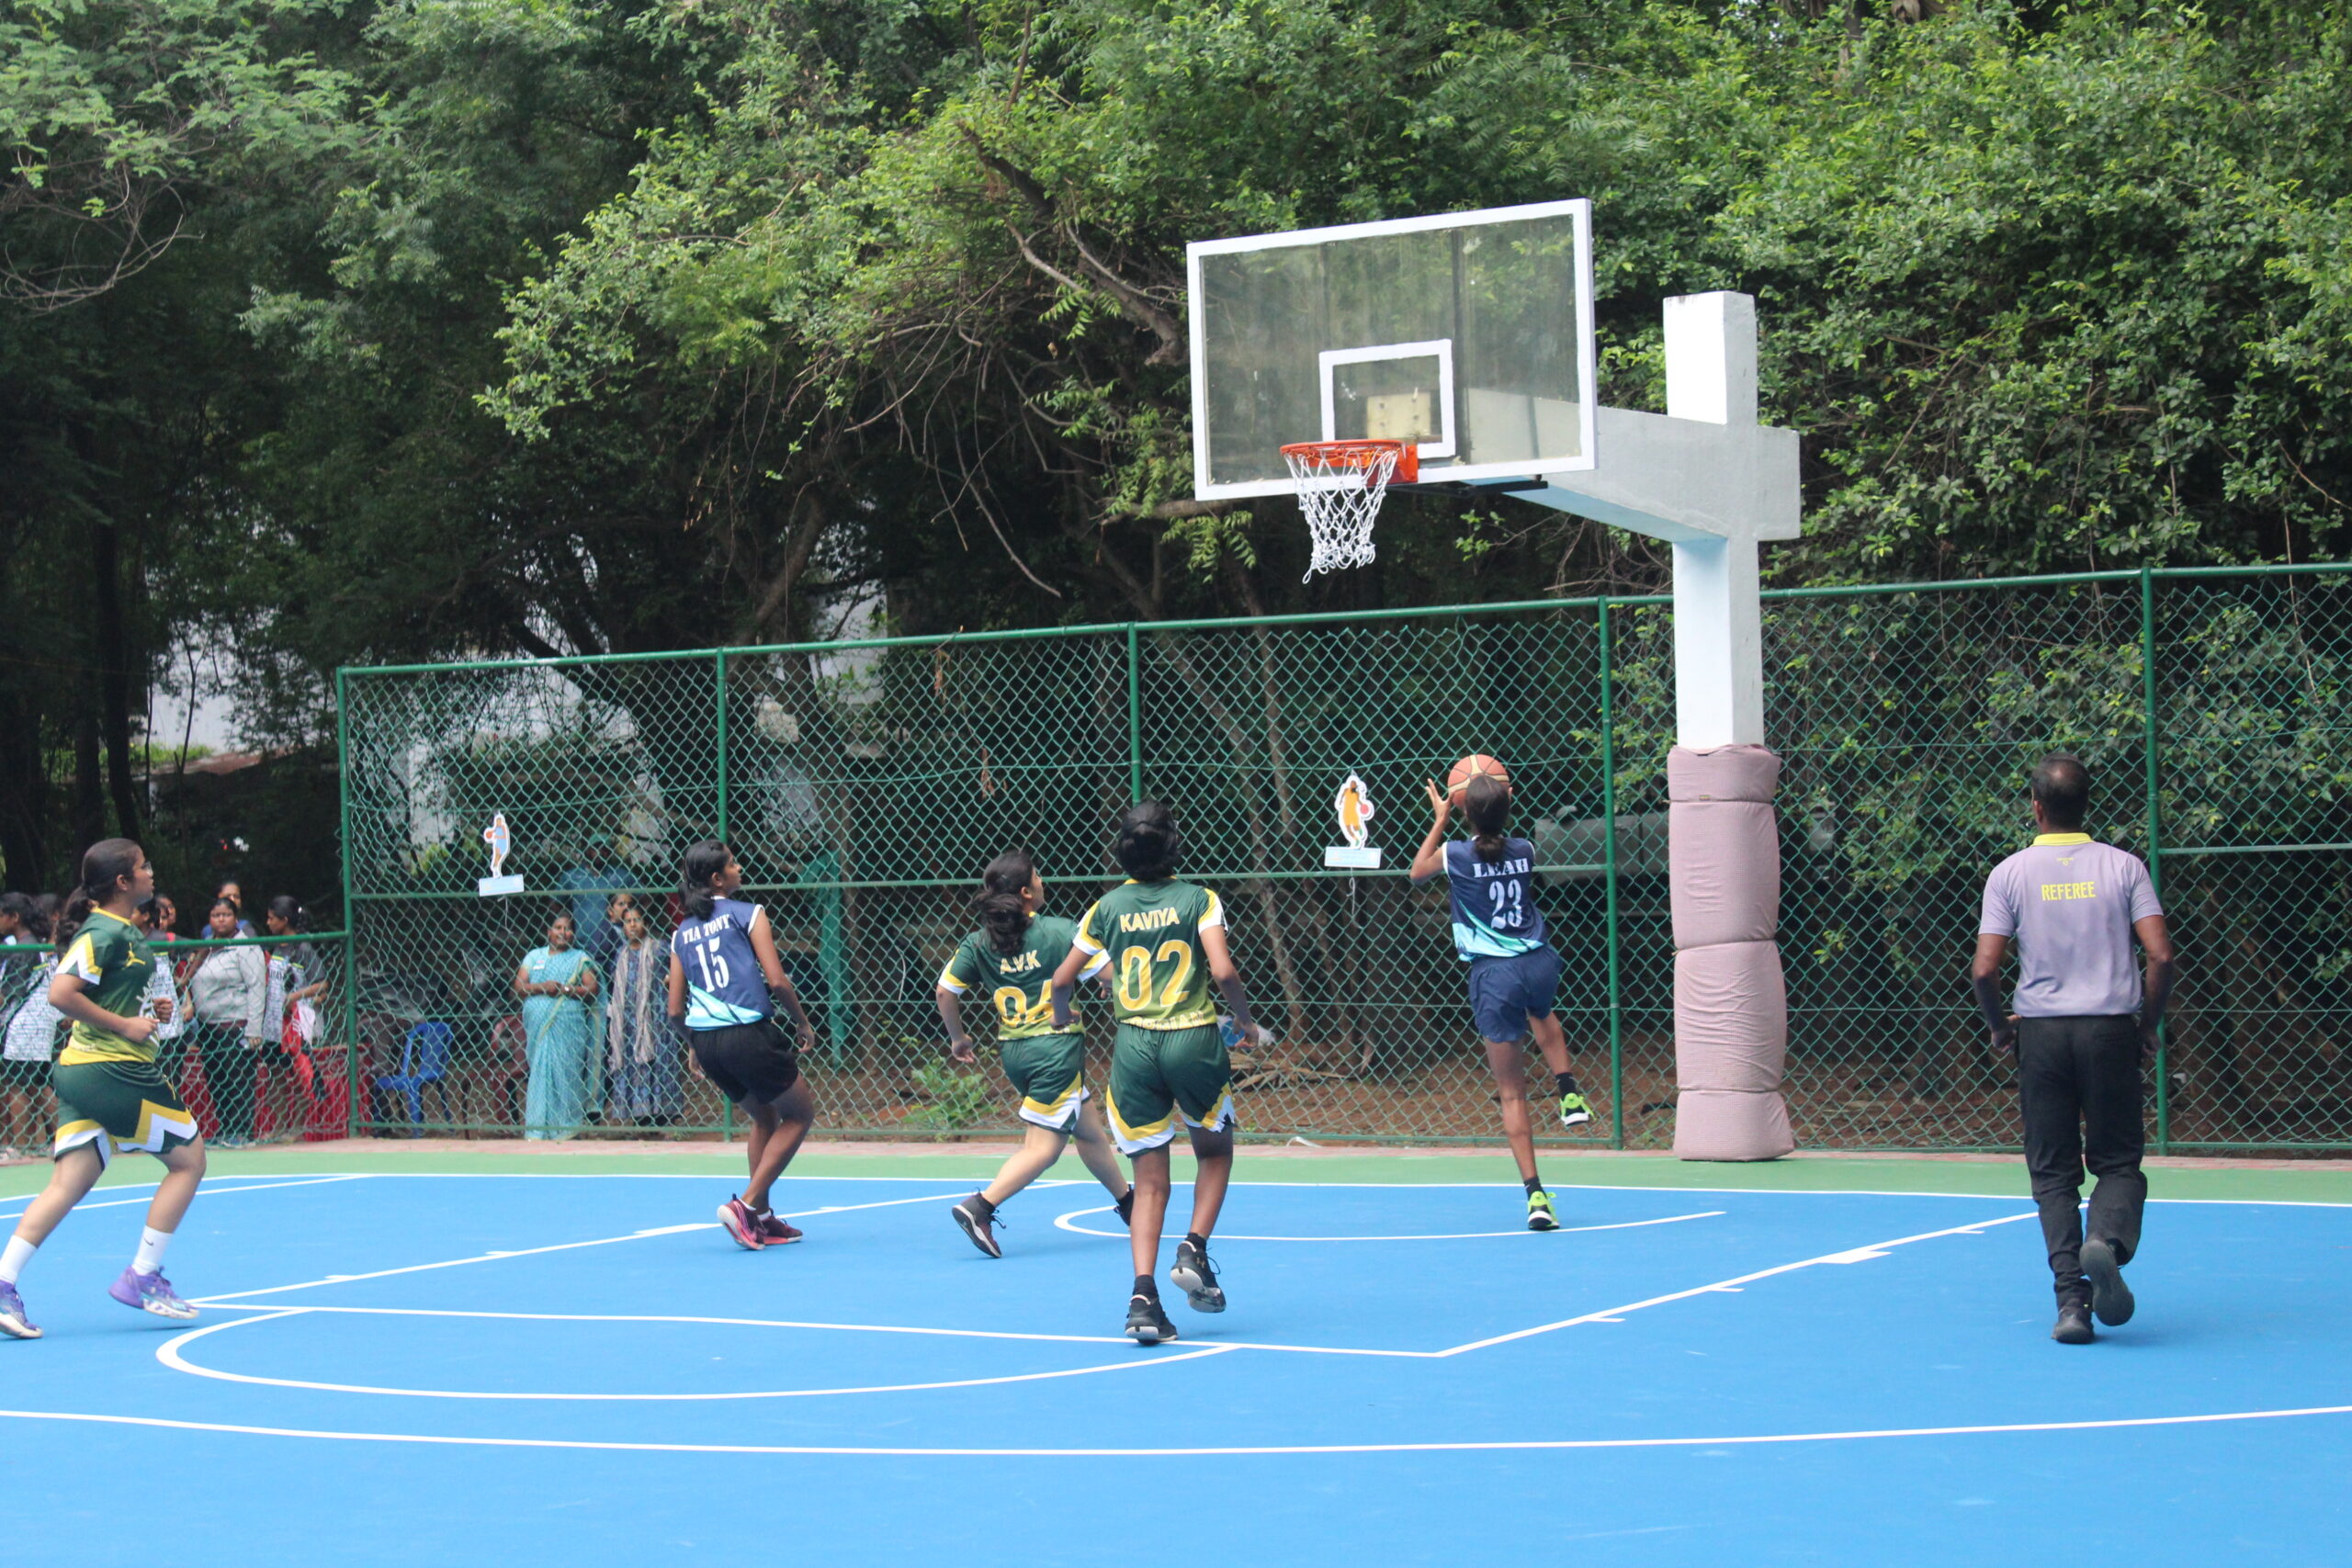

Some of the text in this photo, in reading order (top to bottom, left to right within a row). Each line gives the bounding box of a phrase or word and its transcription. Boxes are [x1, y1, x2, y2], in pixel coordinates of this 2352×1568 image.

[1473, 858, 1530, 878] LEAH
[1488, 878, 1523, 930] 23
[2041, 881, 2097, 901] REFEREE
[682, 914, 731, 944] TIA TONY
[1119, 907, 1180, 933] KAVIYA
[695, 937, 730, 993] 15
[1118, 939, 1192, 1011] 02
